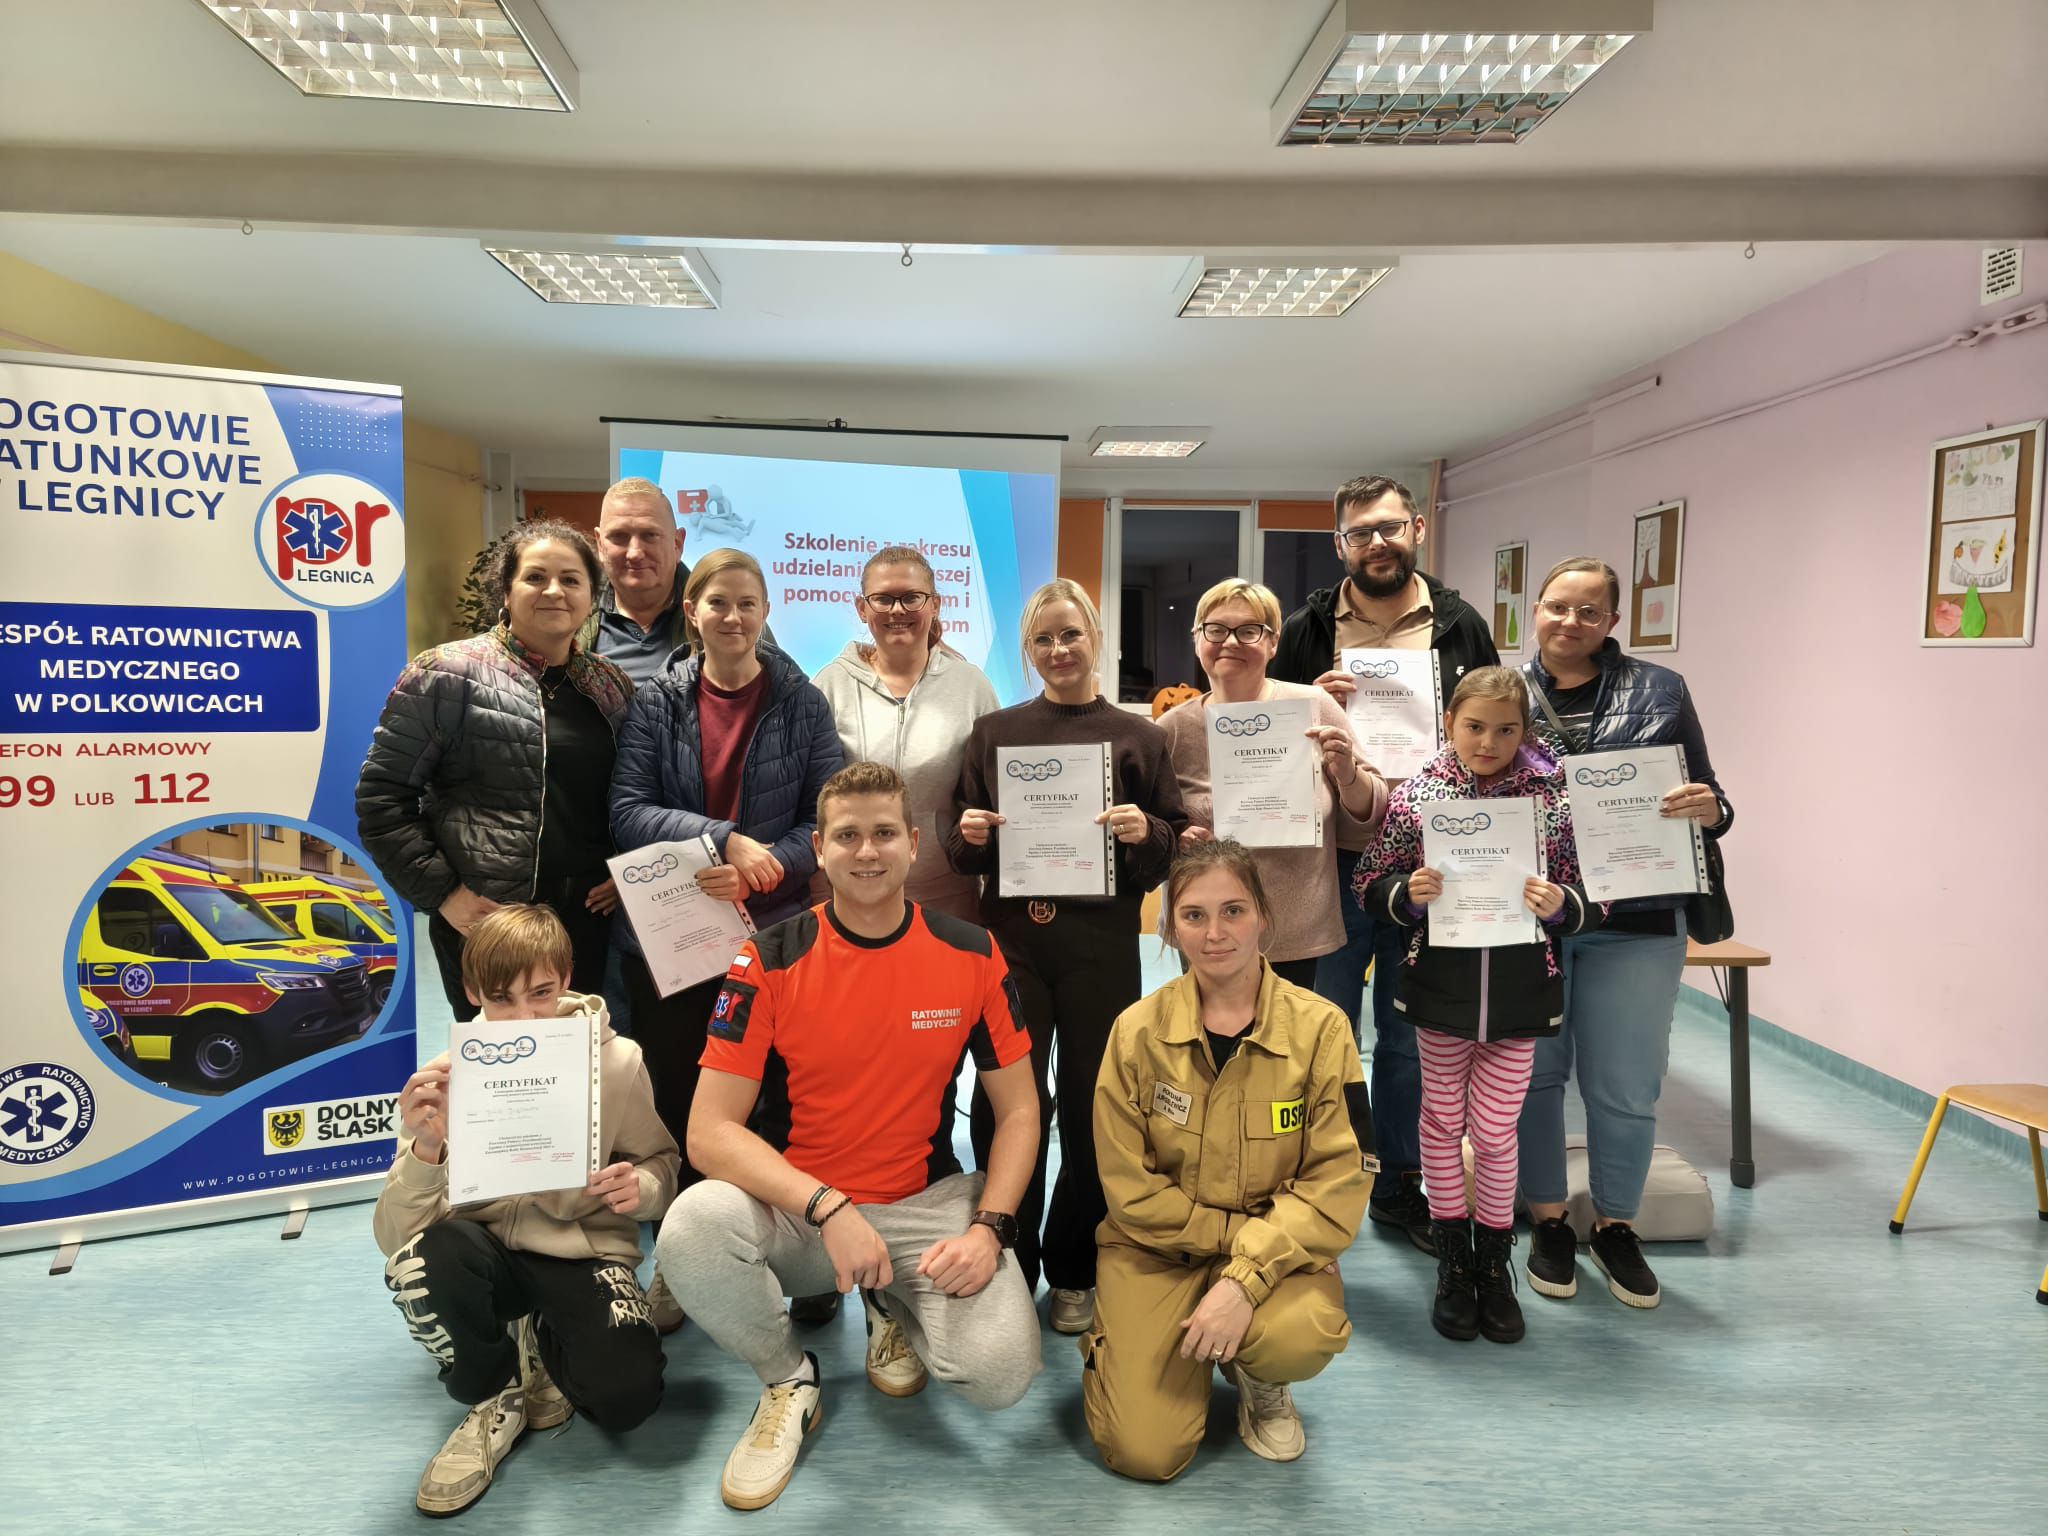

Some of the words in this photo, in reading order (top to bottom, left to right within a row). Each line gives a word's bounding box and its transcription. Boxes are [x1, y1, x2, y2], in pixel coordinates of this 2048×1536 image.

[0, 398, 250, 447] OGOTOWIE
[0, 438, 262, 485] ATUNKOWE
[18, 480, 225, 520] LEGNICY
[784, 532, 877, 553] Szkolenie
[297, 569, 374, 584] LEGNICA
[934, 566, 971, 587] szej
[0, 620, 83, 646] SPÓŁ
[91, 627, 302, 649] RATOWNICTWA
[39, 659, 240, 681] MEDYCZNEGO
[15, 693, 43, 713] W
[51, 693, 264, 713] POLKOWICACH
[1365, 689, 1414, 697] CERTYFIKAT
[0, 743, 62, 758] EFON
[76, 742, 211, 757] ALARMOWY
[1234, 747, 1289, 757] CERTYFIKAT
[0, 775, 56, 808] 99
[75, 792, 114, 806] LUB
[134, 772, 211, 804] 112
[1024, 793, 1080, 802] CERTYFIKAT
[1597, 796, 1659, 808] CERTYFIKAT
[1451, 847, 1512, 856] CERTYFIKAT
[651, 882, 697, 901] CERTYFIK
[911, 1008, 962, 1020] RATOWNIK
[484, 1076, 558, 1090] CERTYFIKAT
[0, 1069, 24, 1090] WE
[41, 1066, 92, 1129] RATOWNICTWO
[317, 1098, 399, 1123] DOLNY
[1280, 1103, 1304, 1129] OSP
[317, 1116, 394, 1142] ŚLĄSK
